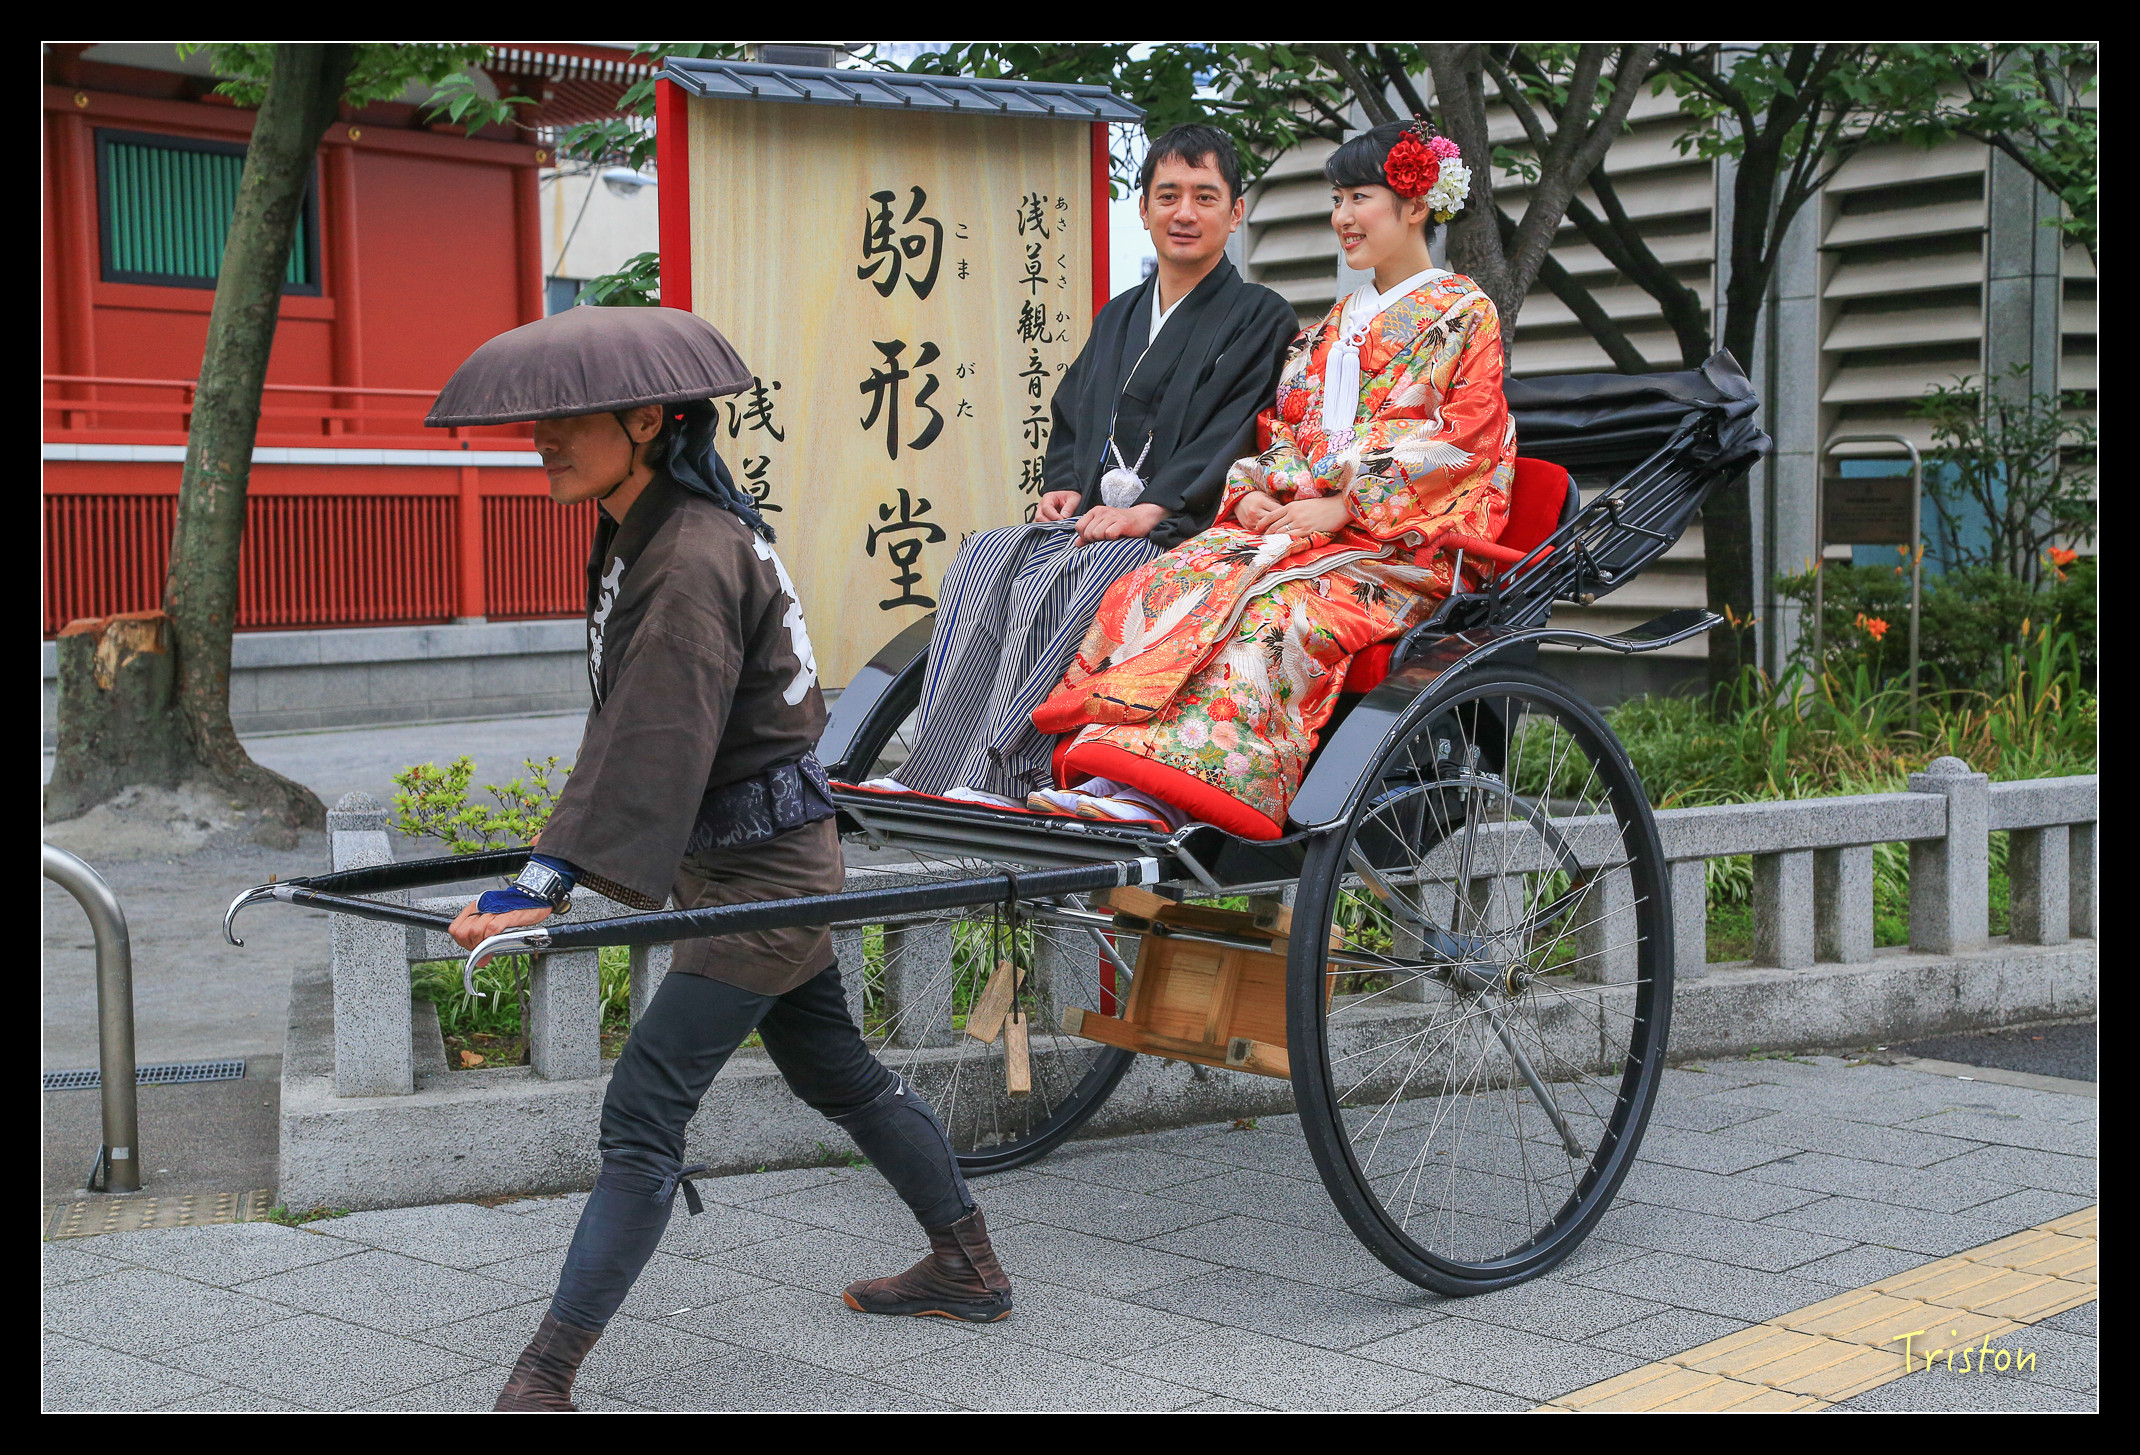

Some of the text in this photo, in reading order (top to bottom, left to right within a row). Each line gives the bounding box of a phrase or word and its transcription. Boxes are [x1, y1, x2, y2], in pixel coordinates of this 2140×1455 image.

[725, 376, 785, 515] 浅草
[857, 185, 946, 611] 駒形堂
